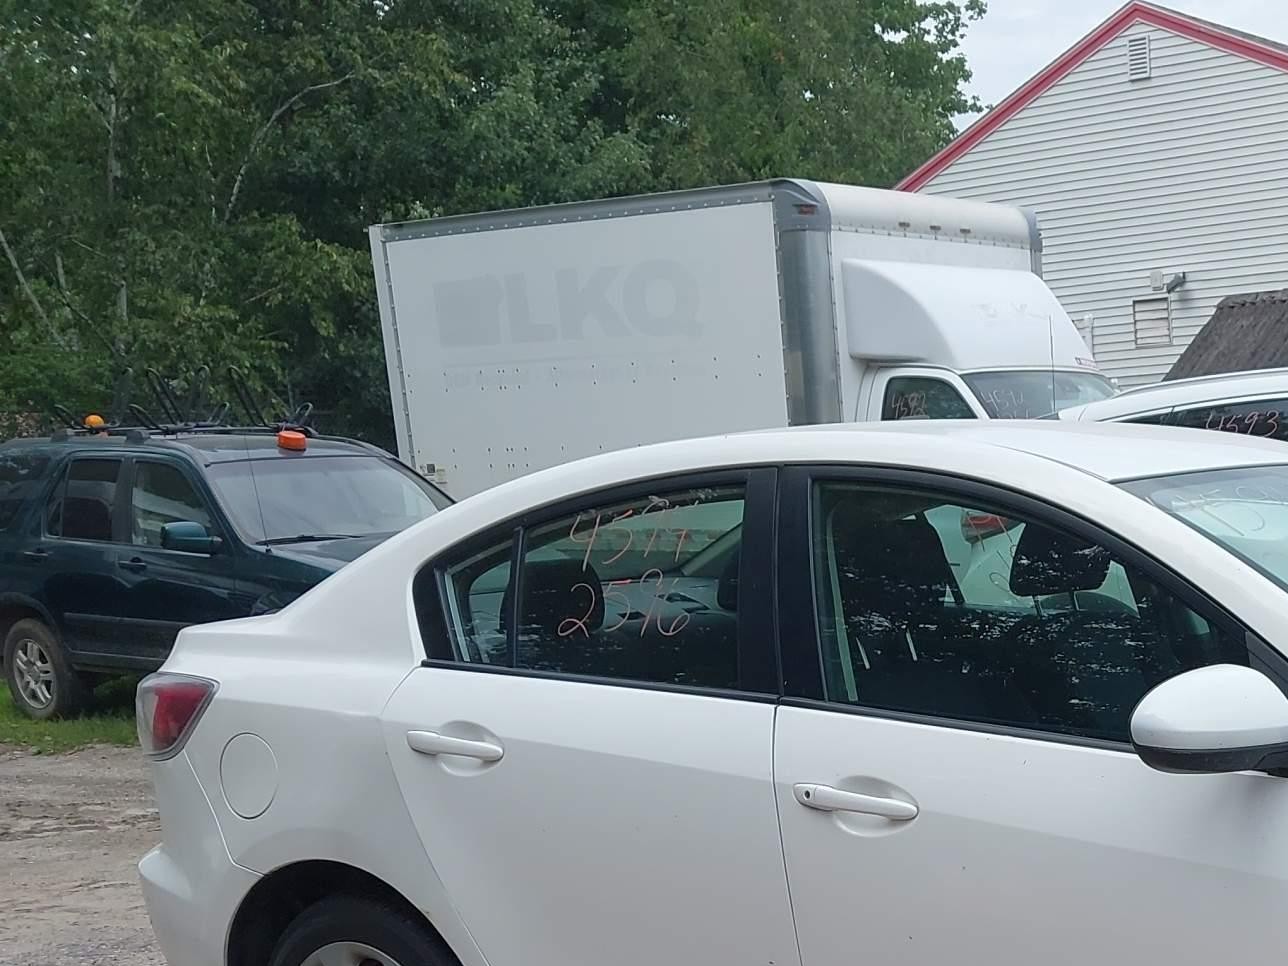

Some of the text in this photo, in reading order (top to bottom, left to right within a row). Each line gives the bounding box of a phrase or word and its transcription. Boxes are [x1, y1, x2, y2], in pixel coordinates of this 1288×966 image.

[502, 257, 705, 343] LKQ
[1205, 409, 1279, 437] 4593
[557, 568, 691, 638] 2596
